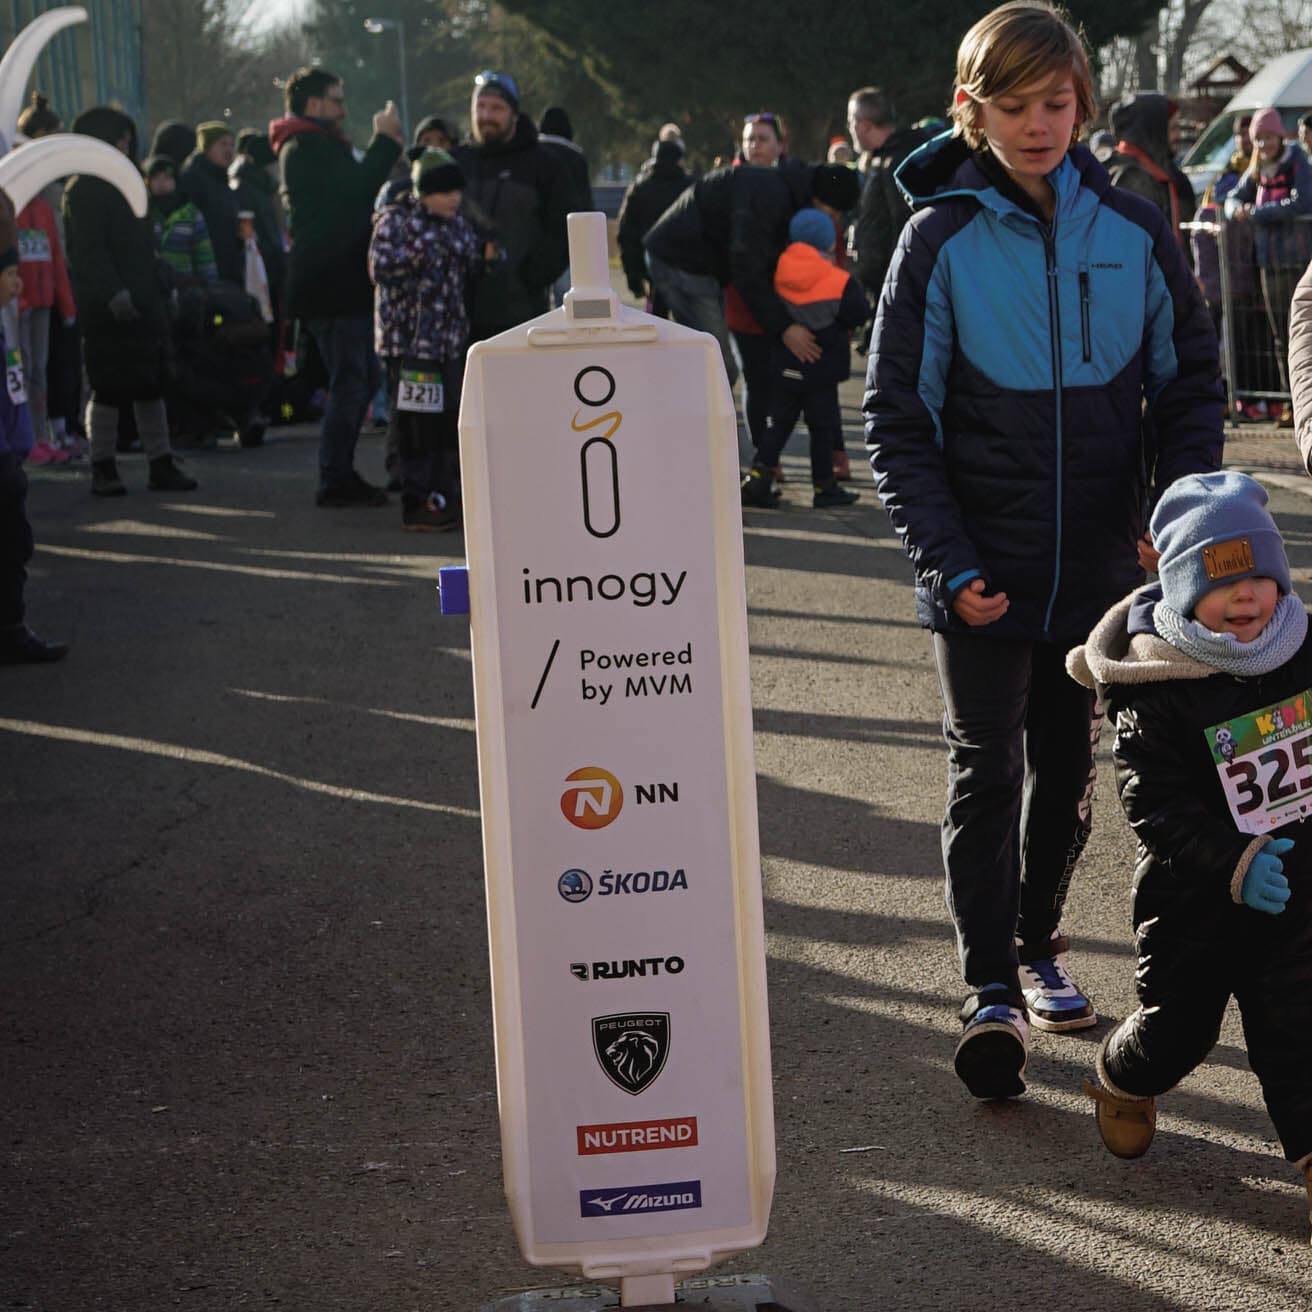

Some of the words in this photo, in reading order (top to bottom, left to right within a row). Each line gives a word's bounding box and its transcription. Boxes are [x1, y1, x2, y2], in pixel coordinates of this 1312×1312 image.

[523, 568, 687, 606] innogy
[580, 643, 692, 670] Powered
[581, 676, 613, 705] by
[625, 673, 692, 698] MVM
[635, 782, 679, 804] NN
[598, 869, 688, 896] ŠKODA
[593, 956, 684, 981] RUNTO
[600, 1019, 662, 1031] PEUGEOT
[585, 1124, 693, 1148] NUTREND
